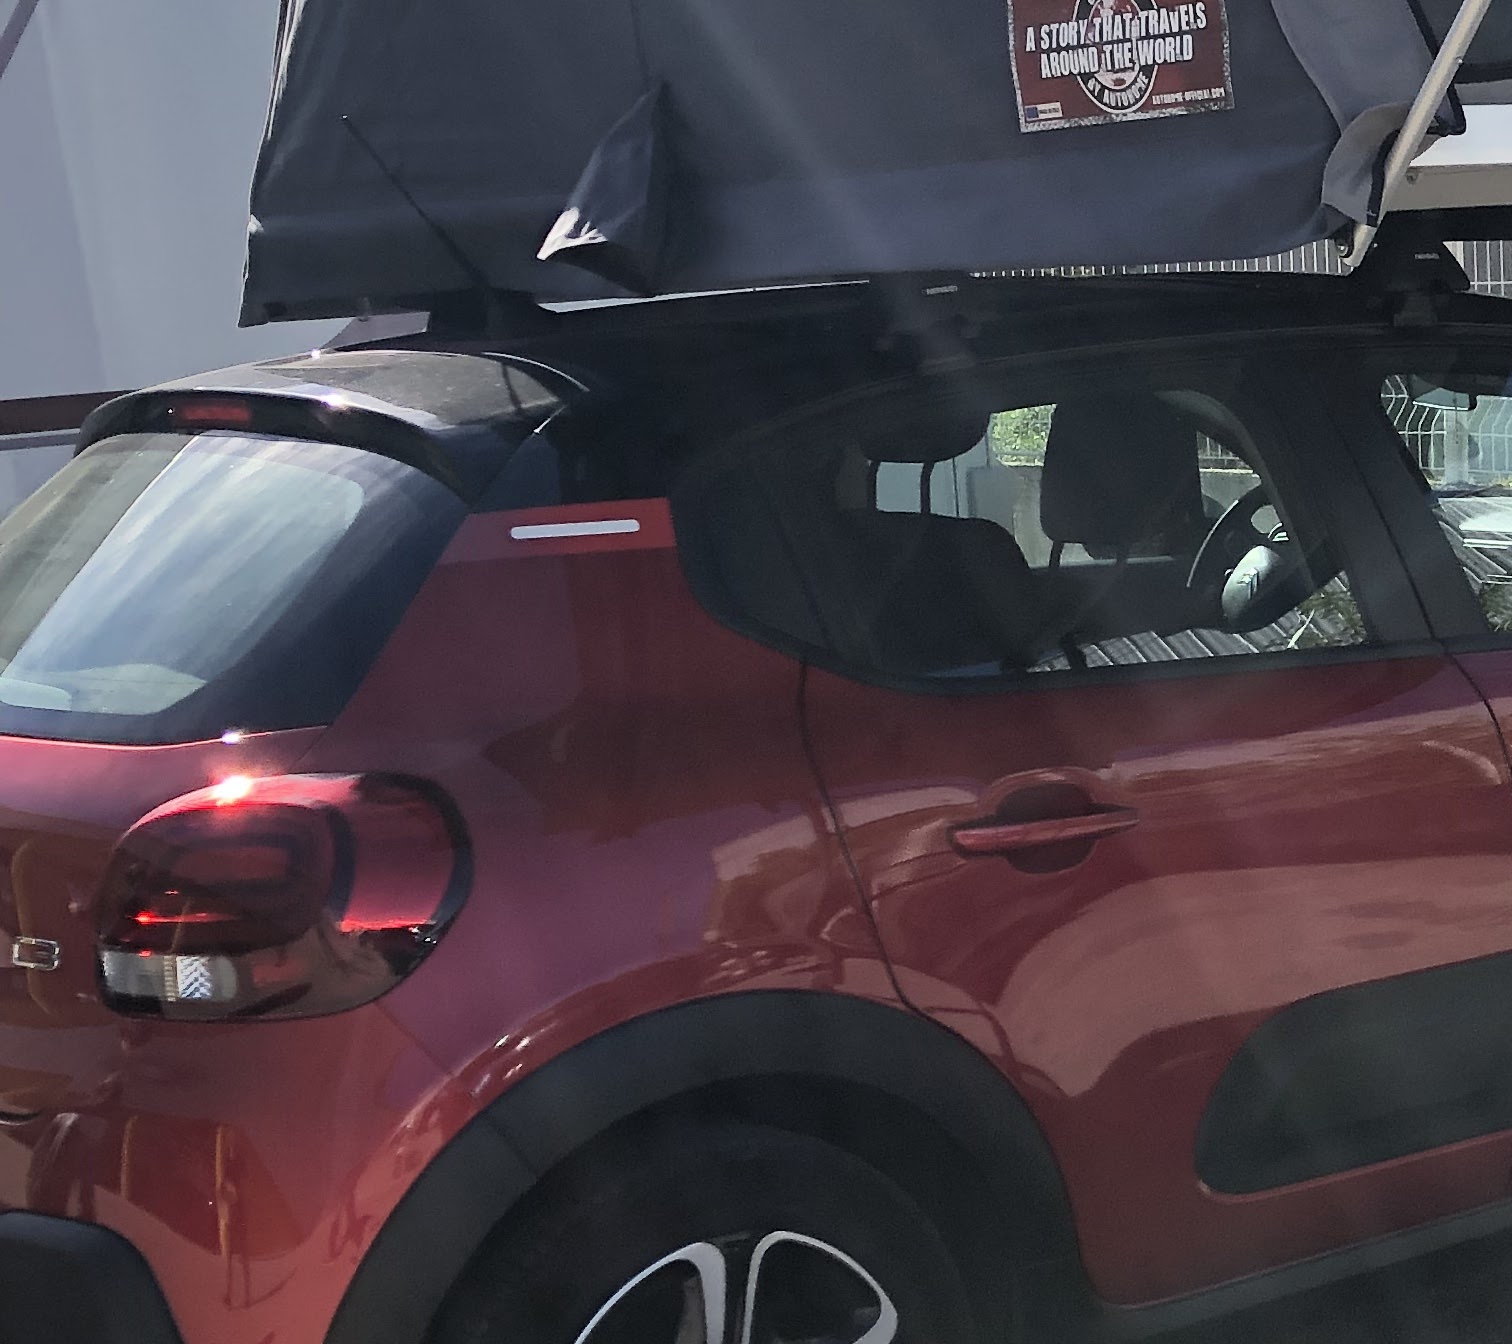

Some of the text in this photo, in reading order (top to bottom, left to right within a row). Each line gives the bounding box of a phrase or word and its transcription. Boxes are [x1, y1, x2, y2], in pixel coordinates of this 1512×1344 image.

[1025, 1, 1207, 52] A STORY THAT TRAVELS
[1040, 34, 1193, 79] AROUND THE WORLD
